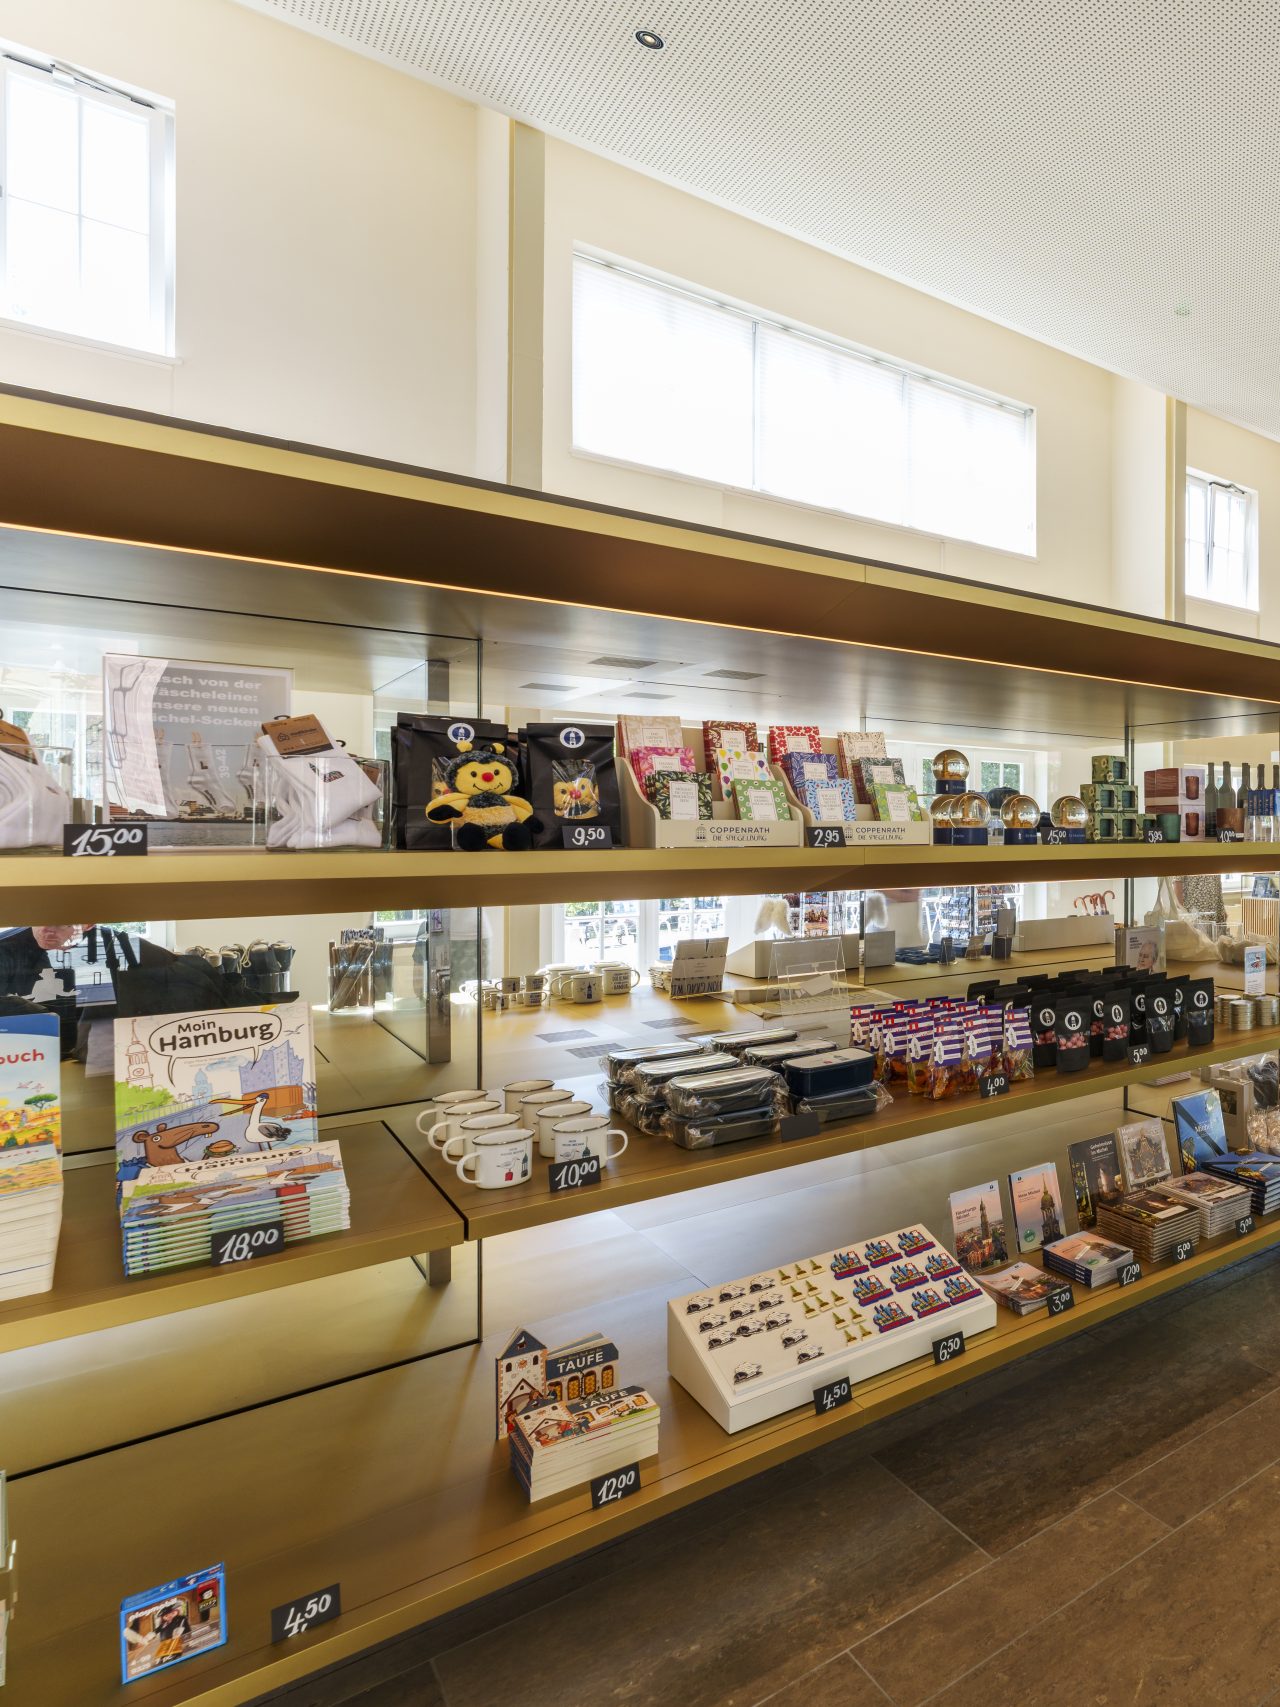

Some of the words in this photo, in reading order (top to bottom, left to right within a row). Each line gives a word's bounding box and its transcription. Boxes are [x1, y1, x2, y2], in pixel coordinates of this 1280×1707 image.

[197, 679, 229, 687] von
[233, 680, 263, 689] der
[152, 701, 202, 711] nsere
[207, 704, 259, 715] neuen
[153, 712, 262, 727] ichel-Socken
[709, 826, 770, 834] COPPENRATH
[177, 1019, 216, 1034] Moin
[159, 1022, 274, 1053] Hamburg
[557, 1351, 604, 1374] TAUFE
[579, 1389, 628, 1409] TAUFE
